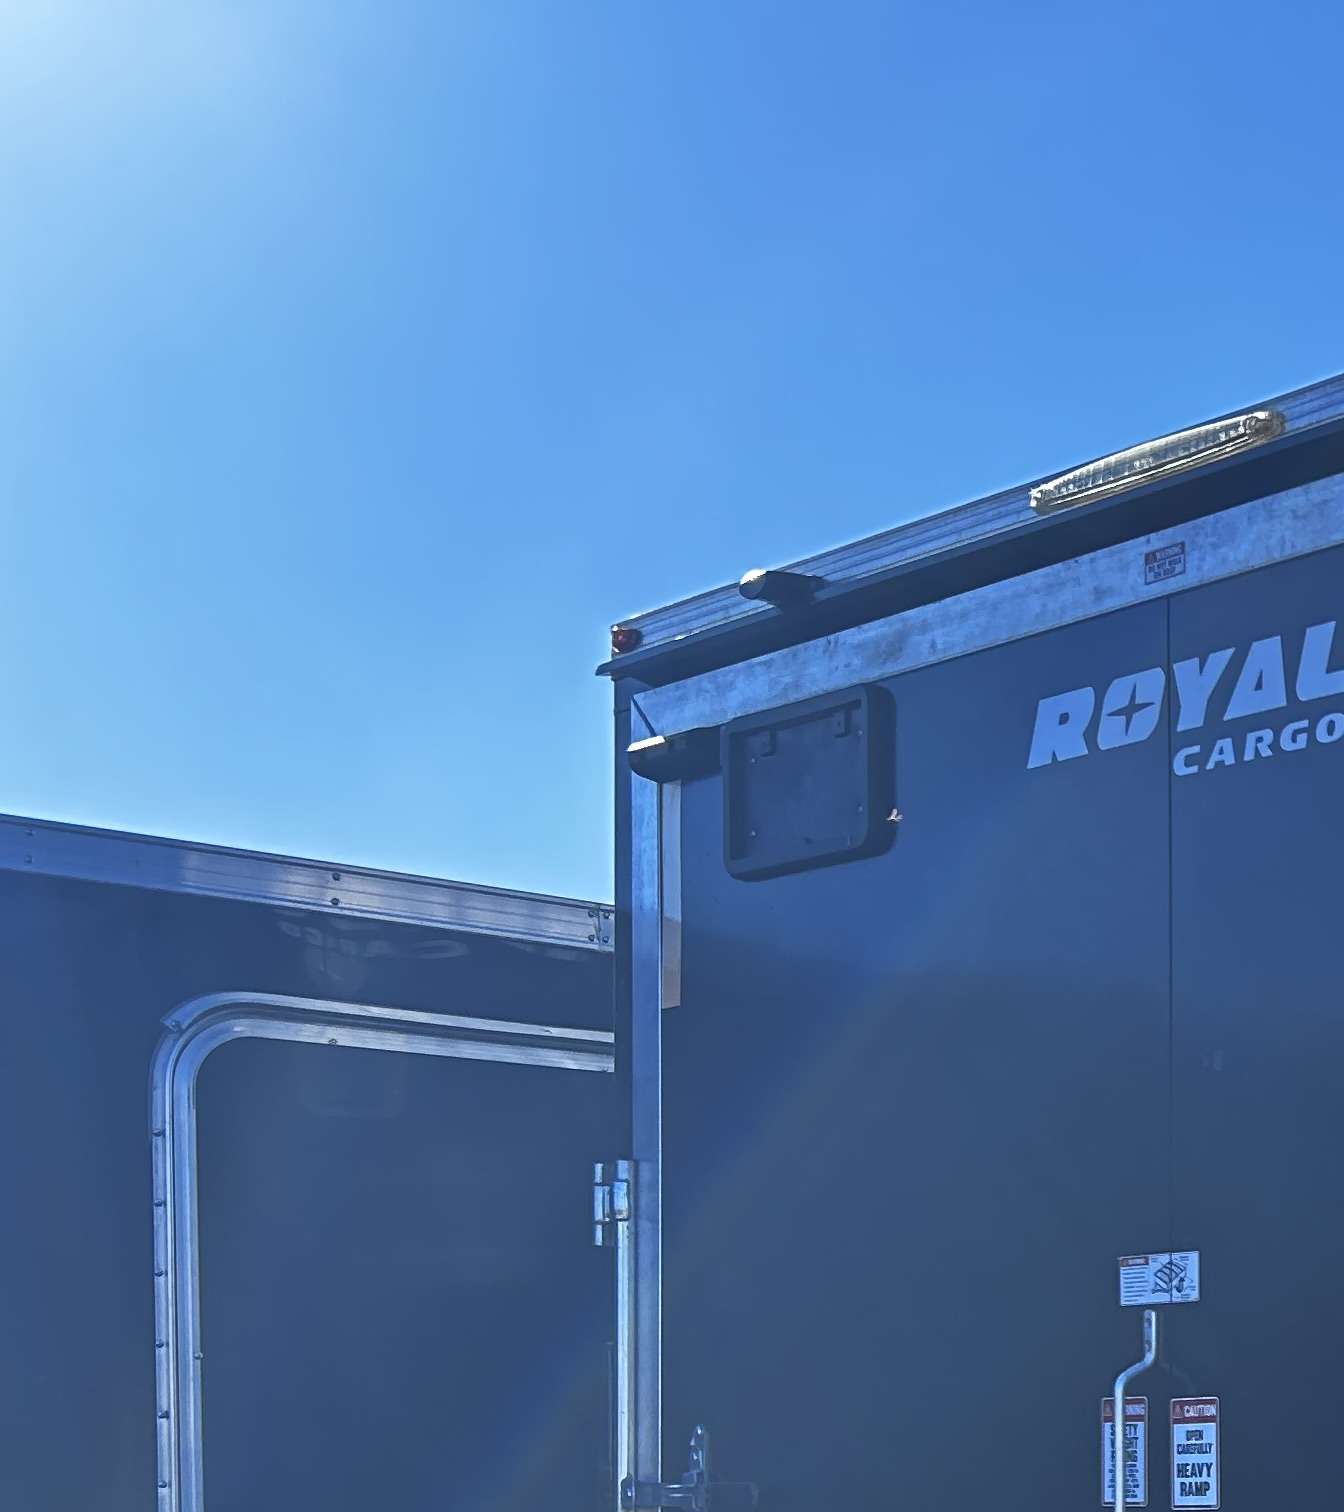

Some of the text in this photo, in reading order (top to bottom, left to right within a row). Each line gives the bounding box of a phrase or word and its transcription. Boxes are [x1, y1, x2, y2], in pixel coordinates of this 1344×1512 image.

[1183, 1404, 1217, 1417] CAUTION
[1176, 1443, 1214, 1455] CAREFULLY
[1176, 1462, 1214, 1479] HEAVY
[1180, 1481, 1211, 1497] RAMP
